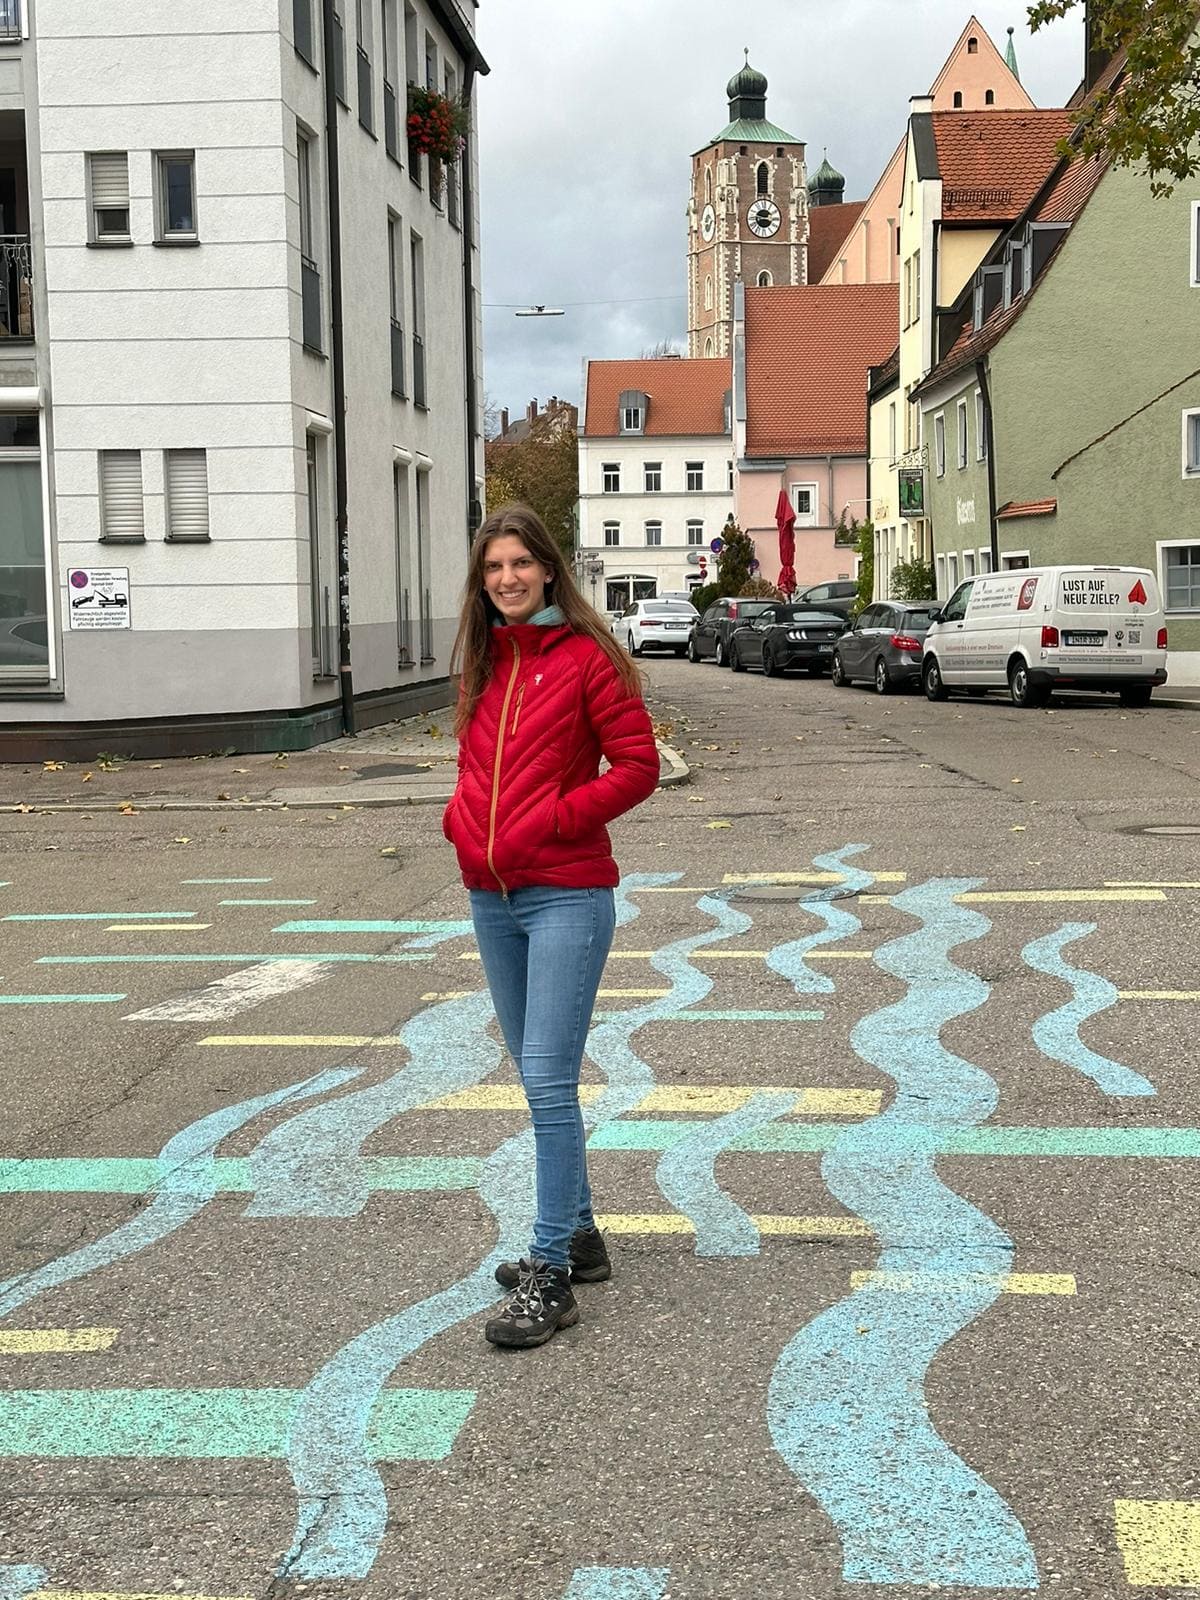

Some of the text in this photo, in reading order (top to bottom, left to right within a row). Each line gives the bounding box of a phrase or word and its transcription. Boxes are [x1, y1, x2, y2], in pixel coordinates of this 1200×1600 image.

[1062, 580, 1105, 591] LUST AUF
[1063, 593, 1120, 605] NEUE ZIELE?
